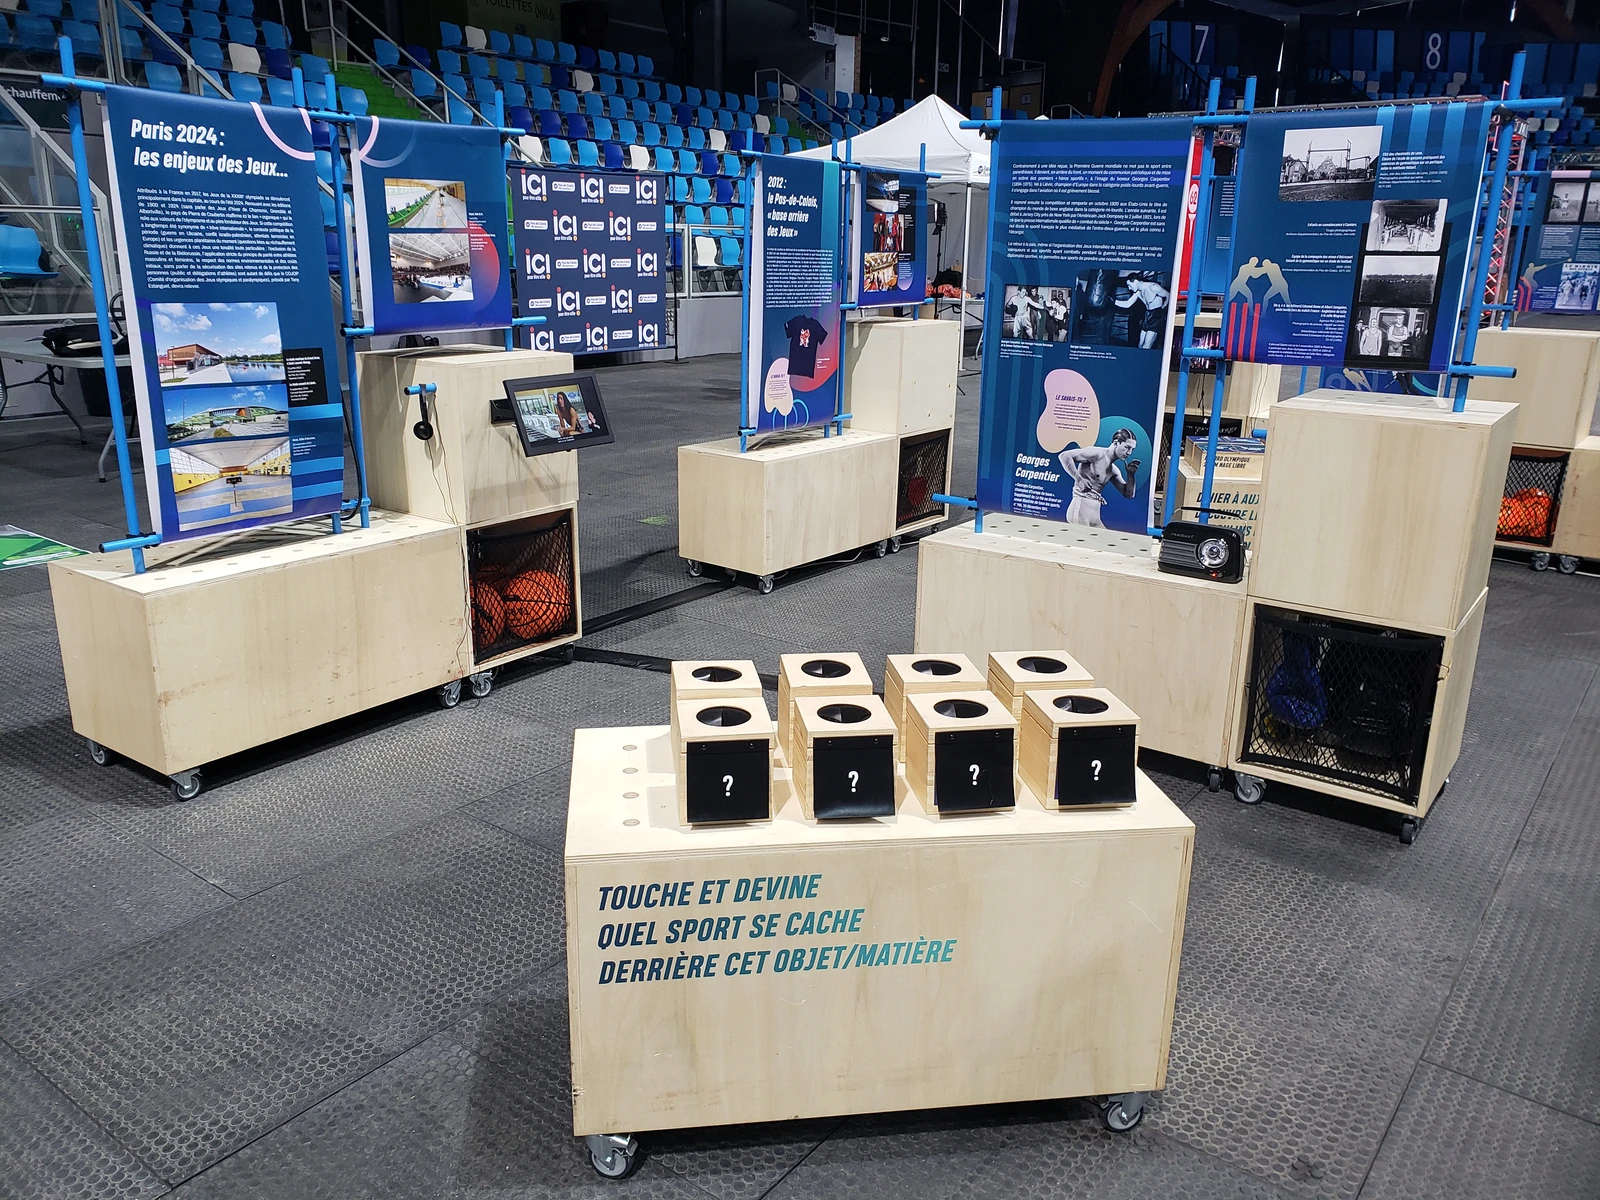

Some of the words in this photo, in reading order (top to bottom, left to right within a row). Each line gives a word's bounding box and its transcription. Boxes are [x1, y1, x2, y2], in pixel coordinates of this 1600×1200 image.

[1195, 24, 1210, 64] 7
[1425, 32, 1442, 70] 8
[131, 119, 173, 141] Paris
[176, 124, 217, 146] 2024
[134, 146, 160, 167] les
[163, 150, 214, 174] enjeux
[217, 154, 244, 174] des
[245, 157, 288, 178] Jeux...
[767, 176, 783, 188] 2012
[768, 192, 774, 204] le
[774, 193, 818, 209] Pas-de-Calais,
[788, 210, 809, 222] arrière
[767, 225, 778, 237] des
[1016, 453, 1050, 468] Georges
[1016, 467, 1060, 482] Carpentier
[1232, 491, 1239, 504] À
[969, 764, 980, 786] ?
[1091, 760, 1102, 780] ?
[722, 774, 734, 796] ?
[848, 771, 860, 792] ?
[598, 882, 694, 910] TOUCHE
[698, 880, 731, 904] ET
[732, 874, 822, 902] DEVINE
[597, 921, 658, 950] QUEL
[666, 916, 747, 944] SPORT
[748, 914, 782, 938] SE
[786, 908, 866, 936] CACHE
[598, 951, 721, 984] DERRIÈRE
[724, 950, 772, 976] CET
[774, 936, 959, 974] OBJET/MATIÈRE
